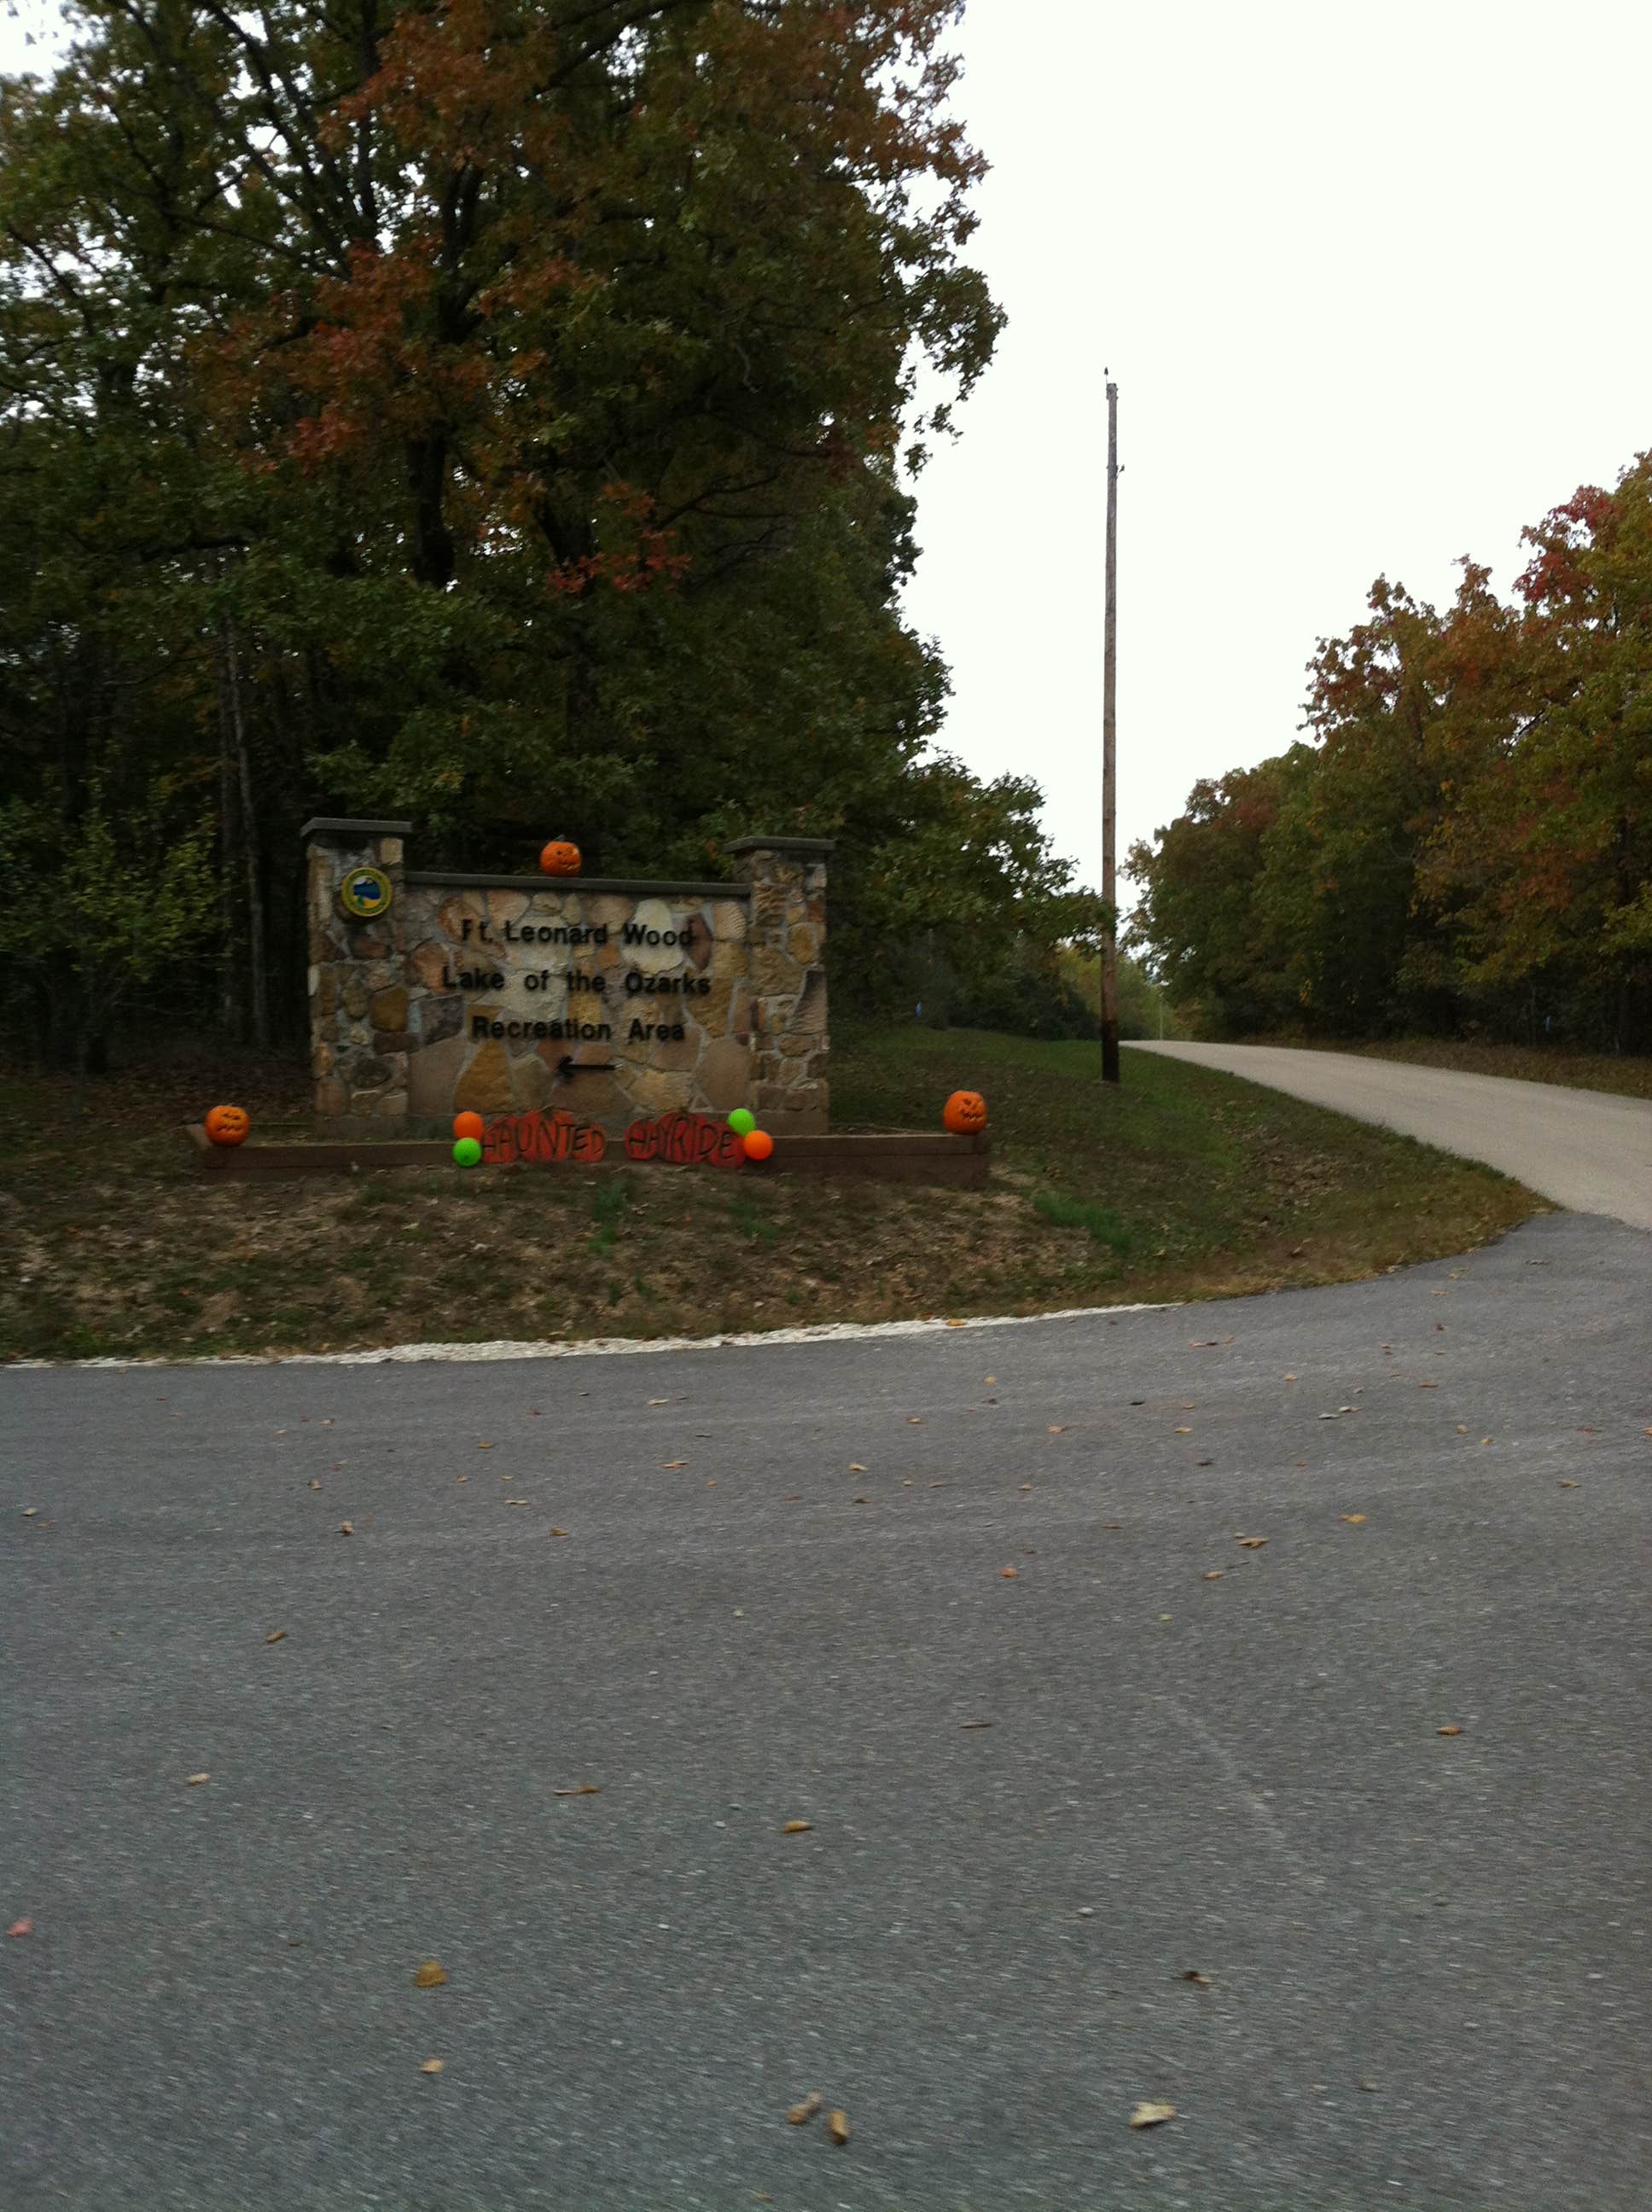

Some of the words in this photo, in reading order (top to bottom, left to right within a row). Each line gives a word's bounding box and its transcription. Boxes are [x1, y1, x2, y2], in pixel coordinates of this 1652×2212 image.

[462, 919, 492, 943] Ft.
[504, 922, 607, 944] Leonard
[622, 923, 694, 946] Wood
[442, 966, 505, 990] Lake
[524, 969, 548, 991] of
[567, 969, 605, 992] the
[625, 972, 710, 995] Ozarks
[472, 1017, 611, 1040] Recreation
[627, 1019, 685, 1043] Area
